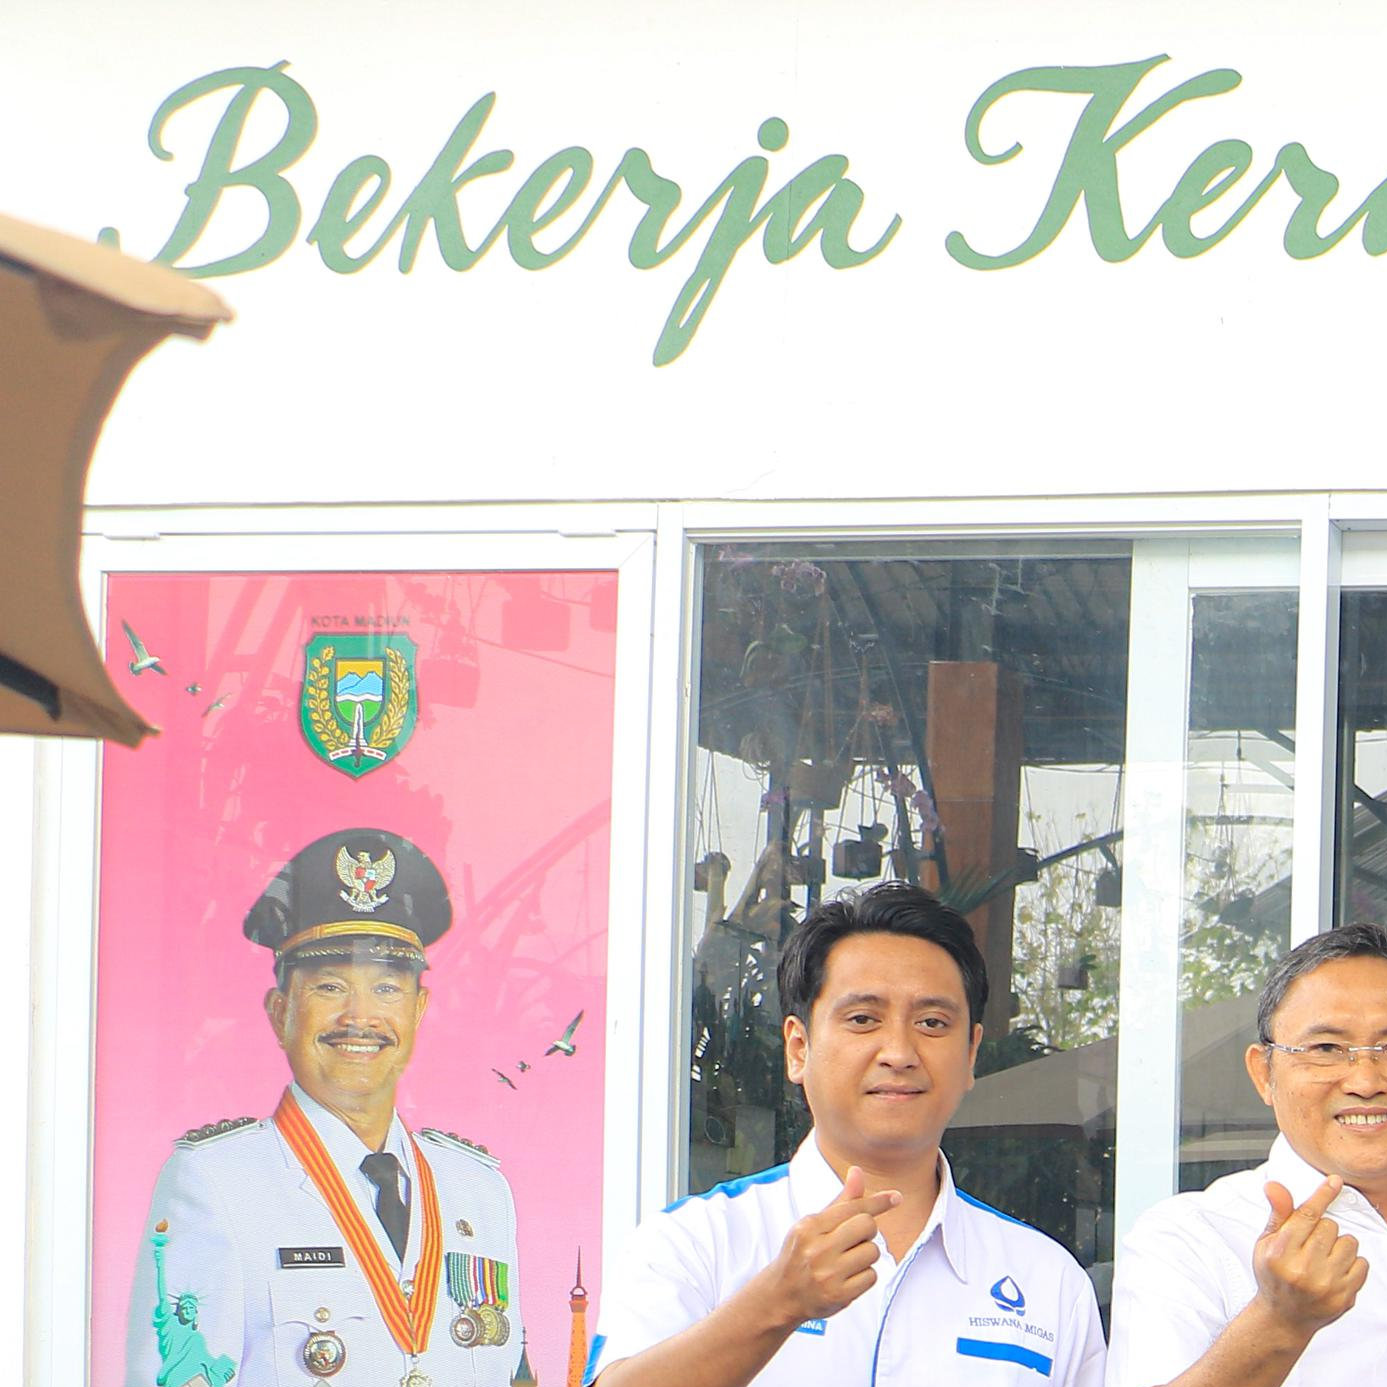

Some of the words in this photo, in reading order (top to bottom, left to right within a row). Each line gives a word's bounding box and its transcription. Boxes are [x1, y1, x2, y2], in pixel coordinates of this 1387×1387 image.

[97, 60, 903, 368] Bekerja
[311, 616, 350, 626] KOTA
[293, 1252, 332, 1262] MAIDI
[968, 1316, 1024, 1330] HISWANA
[1024, 1323, 1056, 1343] MIGAS
